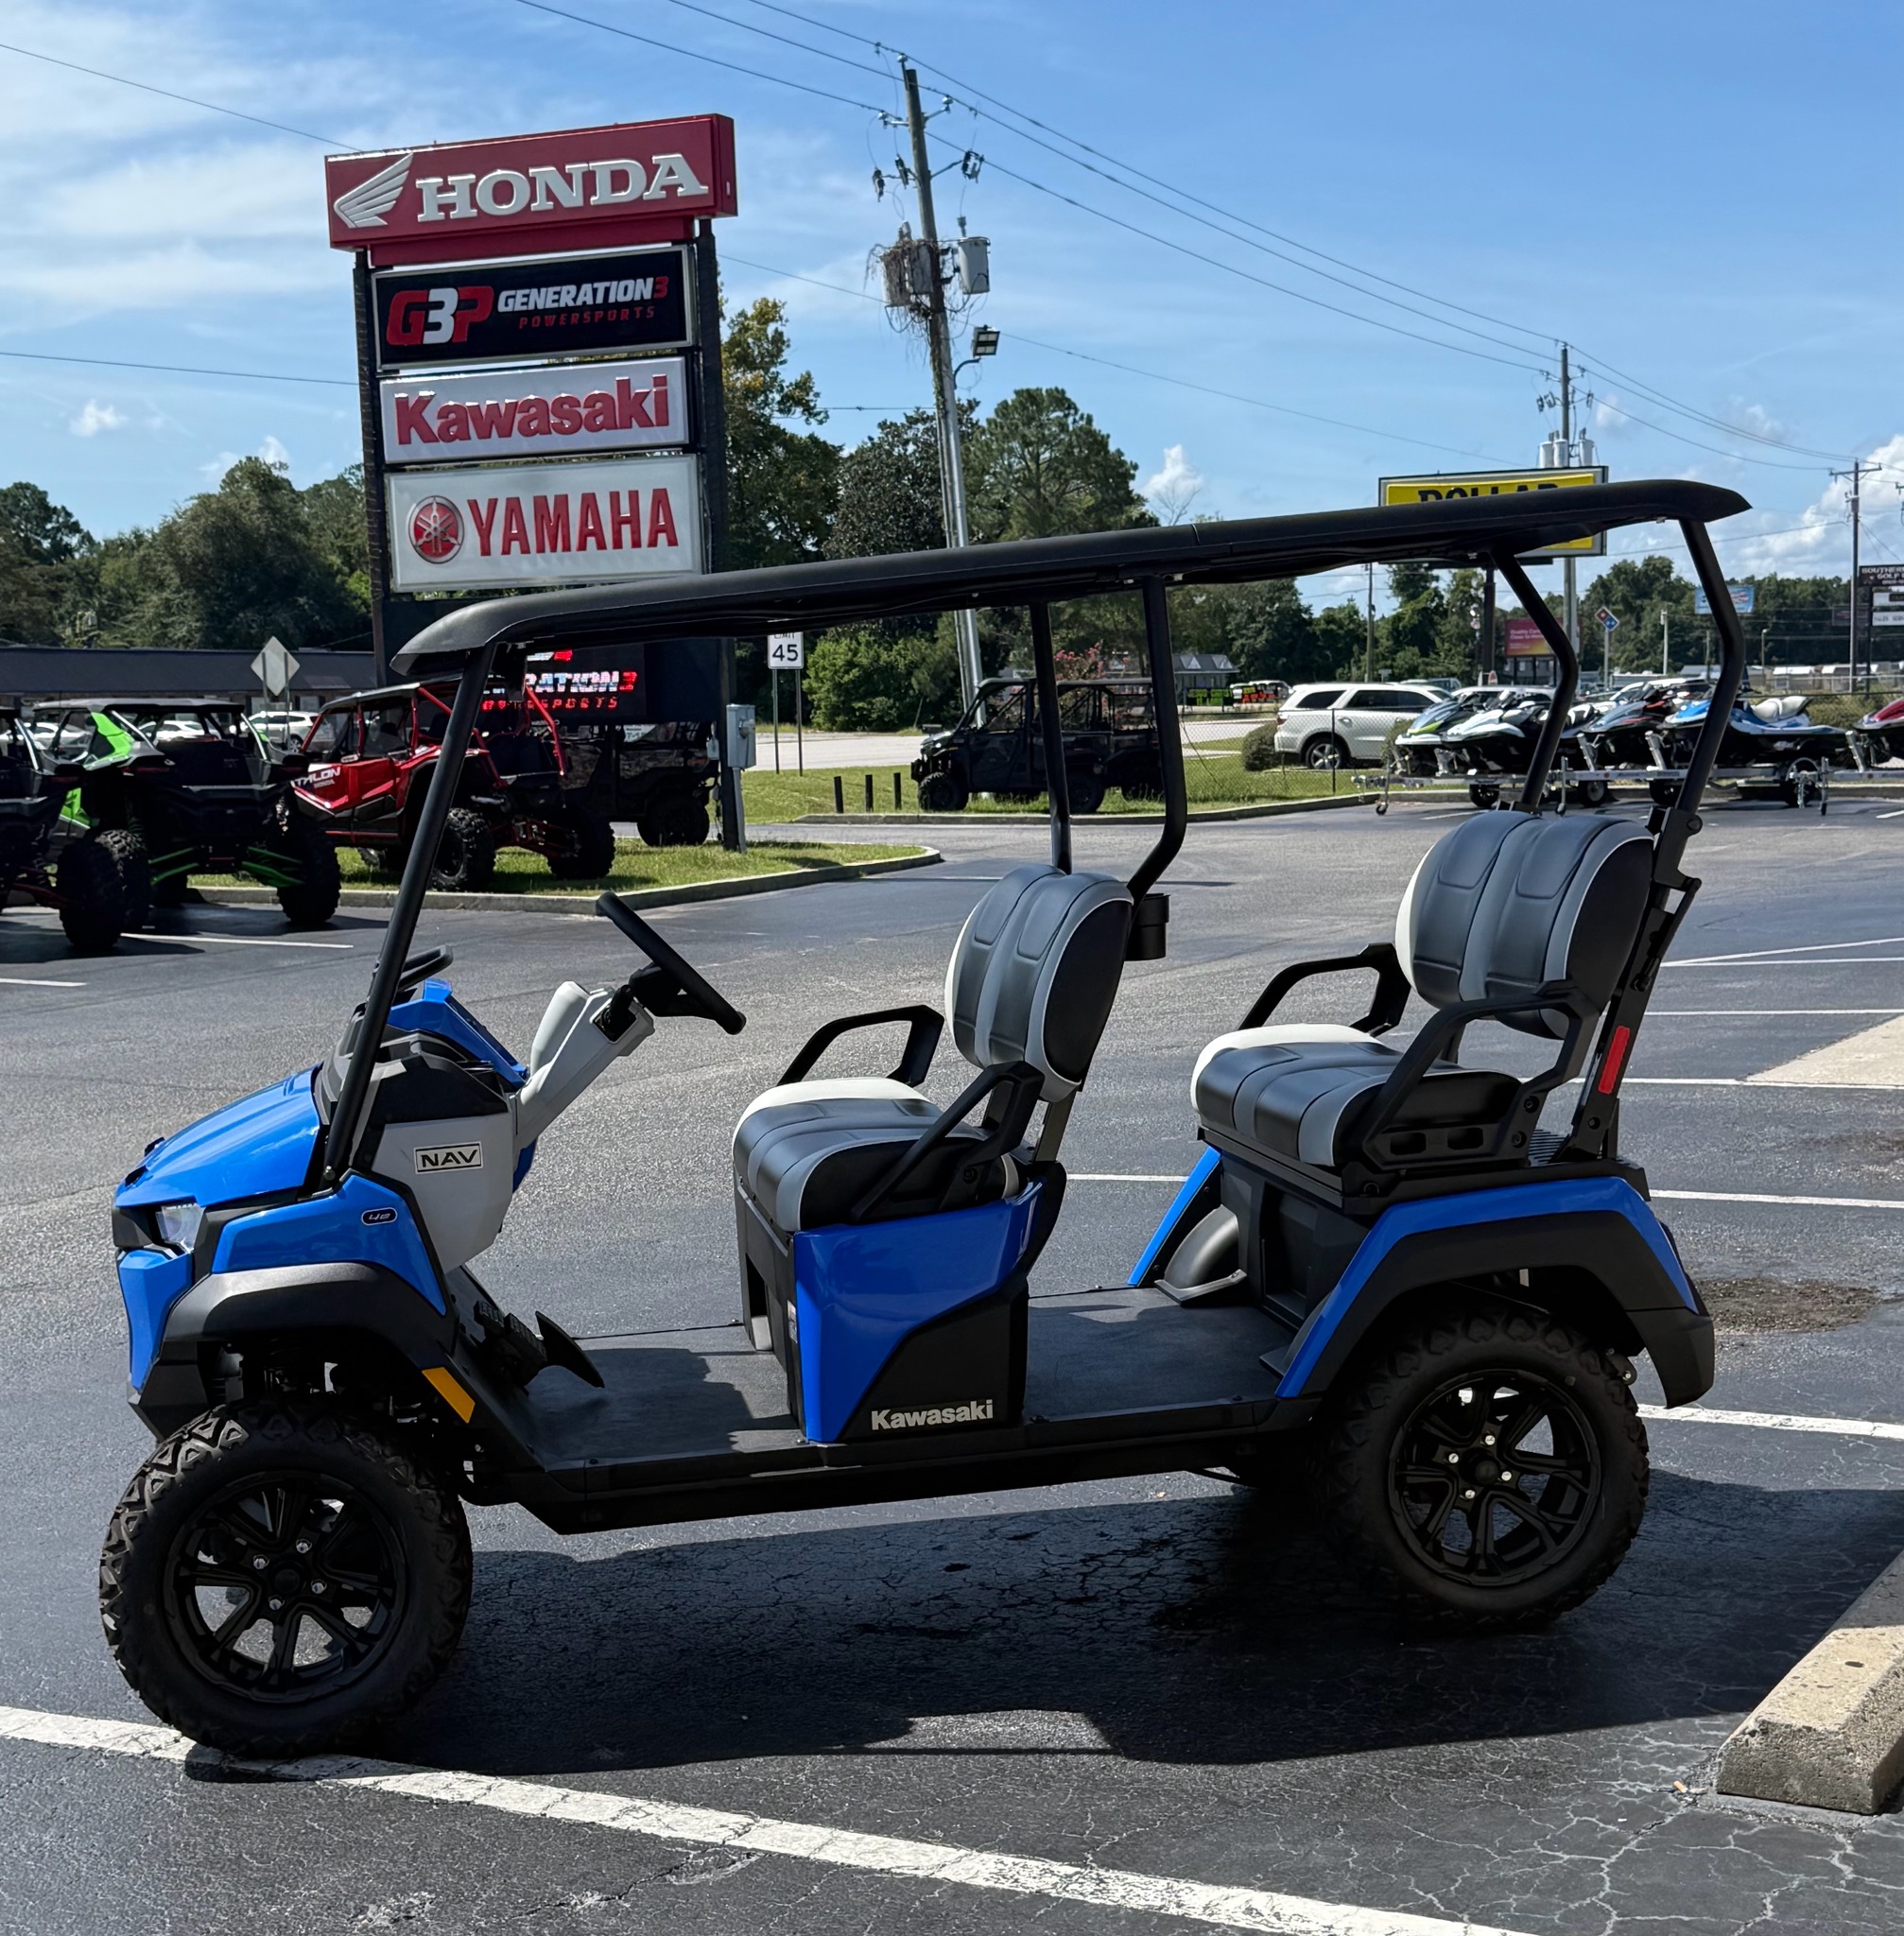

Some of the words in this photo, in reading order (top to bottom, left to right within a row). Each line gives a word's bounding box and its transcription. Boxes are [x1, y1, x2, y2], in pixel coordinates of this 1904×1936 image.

[416, 153, 708, 222] HONDA
[386, 286, 494, 346] G3P
[519, 306, 655, 329] POWERSPORTS
[394, 374, 669, 445] Kawasaki
[467, 488, 678, 558] YAMAHA
[772, 644, 798, 662] 45
[295, 767, 341, 786] TALON
[421, 1150, 478, 1167] NAV
[872, 1399, 993, 1430] Kawasaki
